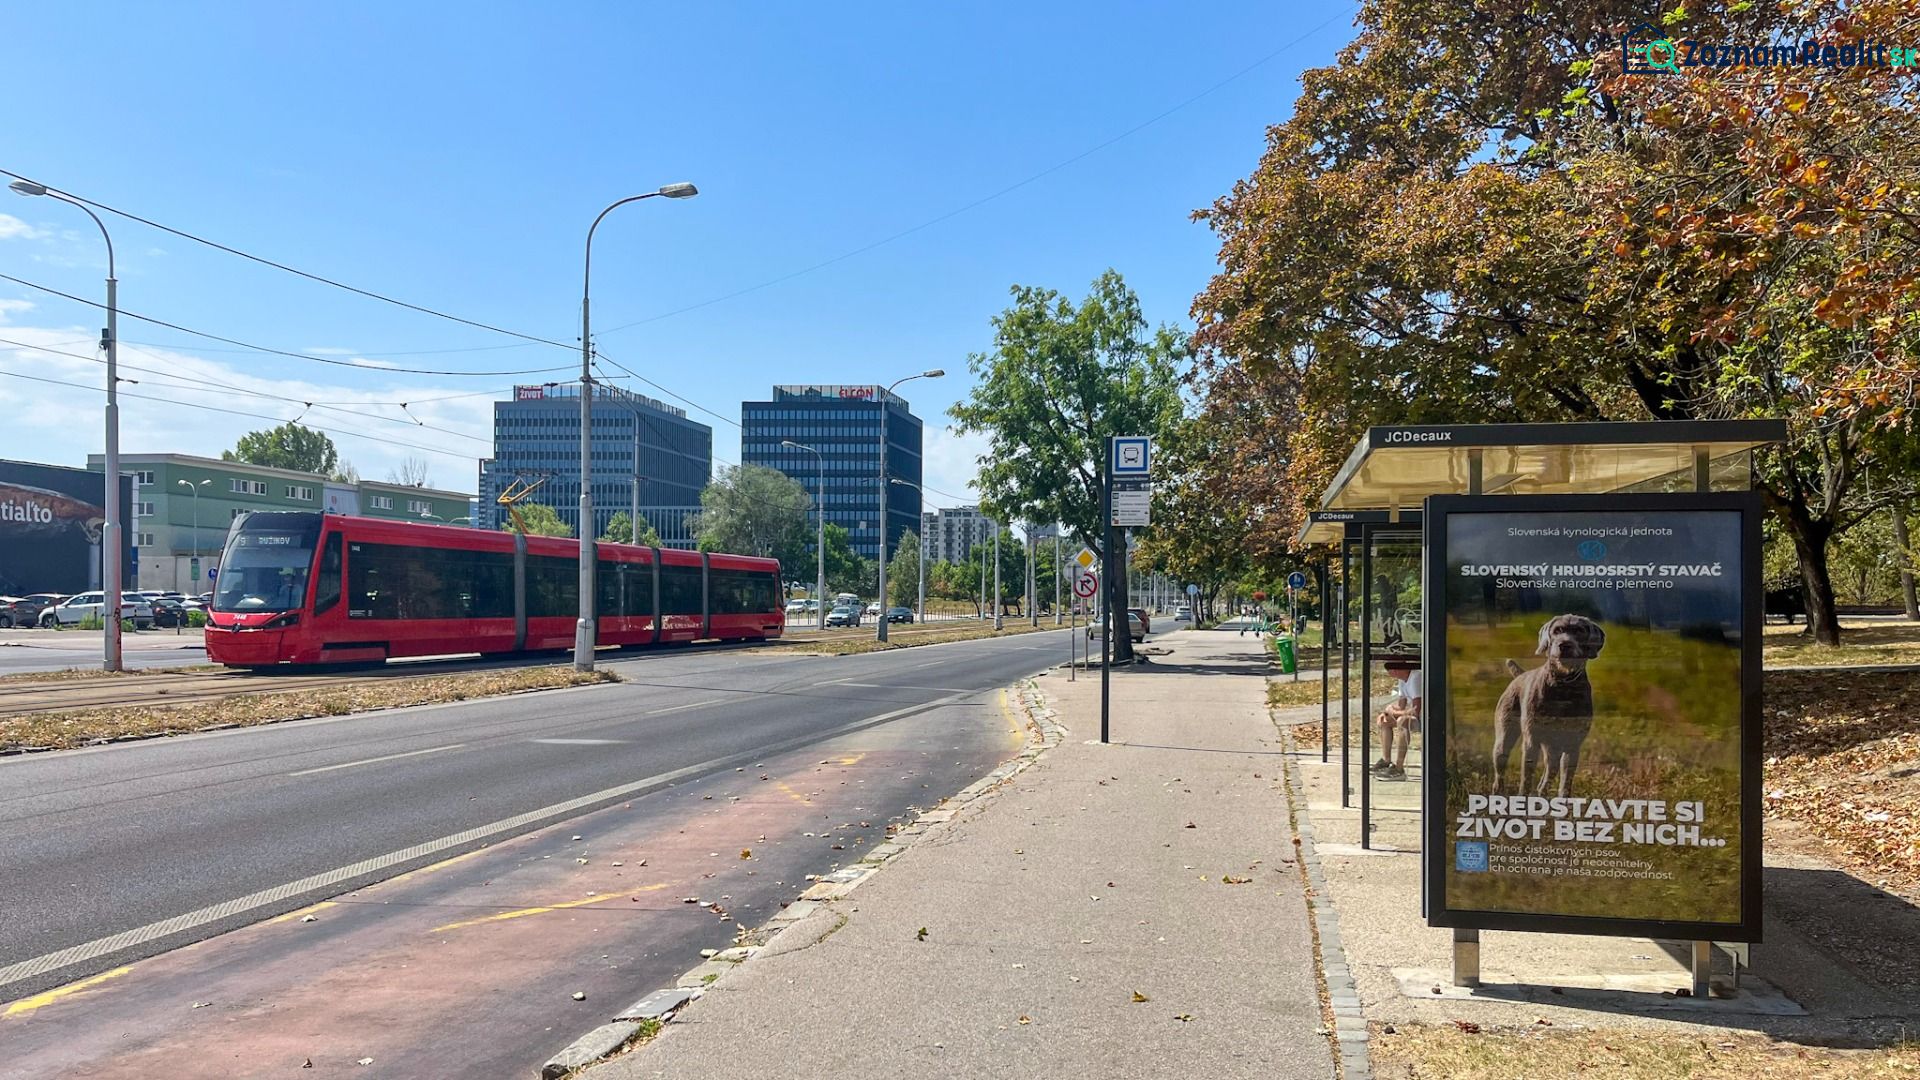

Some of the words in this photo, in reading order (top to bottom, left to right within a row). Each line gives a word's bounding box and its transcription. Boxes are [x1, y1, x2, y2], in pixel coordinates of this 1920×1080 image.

[1385, 431, 1452, 443] JCDecaux
[0, 500, 52, 523] tiaľto
[1318, 512, 1354, 520] JCDecaux
[1507, 527, 1560, 536] Slovenská
[1563, 527, 1628, 538] kynologická
[1629, 527, 1673, 538] jednota
[1461, 562, 1549, 576] SLOVENSKÝ
[1552, 562, 1656, 576] HRUBOSRSTÝ
[1658, 562, 1722, 576] STAVAČ
[1496, 578, 1557, 589] Slovenské
[1559, 578, 1613, 589] národné
[1616, 578, 1674, 590] plemeno
[1468, 794, 1667, 821] PREDSTAVTE
[1675, 801, 1704, 822] SI
[1456, 812, 1546, 840] ŽIVOT
[1554, 820, 1615, 842] BEZ
[1622, 823, 1726, 847] NICH...
[1489, 854, 1507, 863] pre
[1595, 848, 1621, 857] psov
[1507, 864, 1552, 875] ochrana
[1553, 867, 1564, 876] je
[1566, 867, 1592, 876] naša
